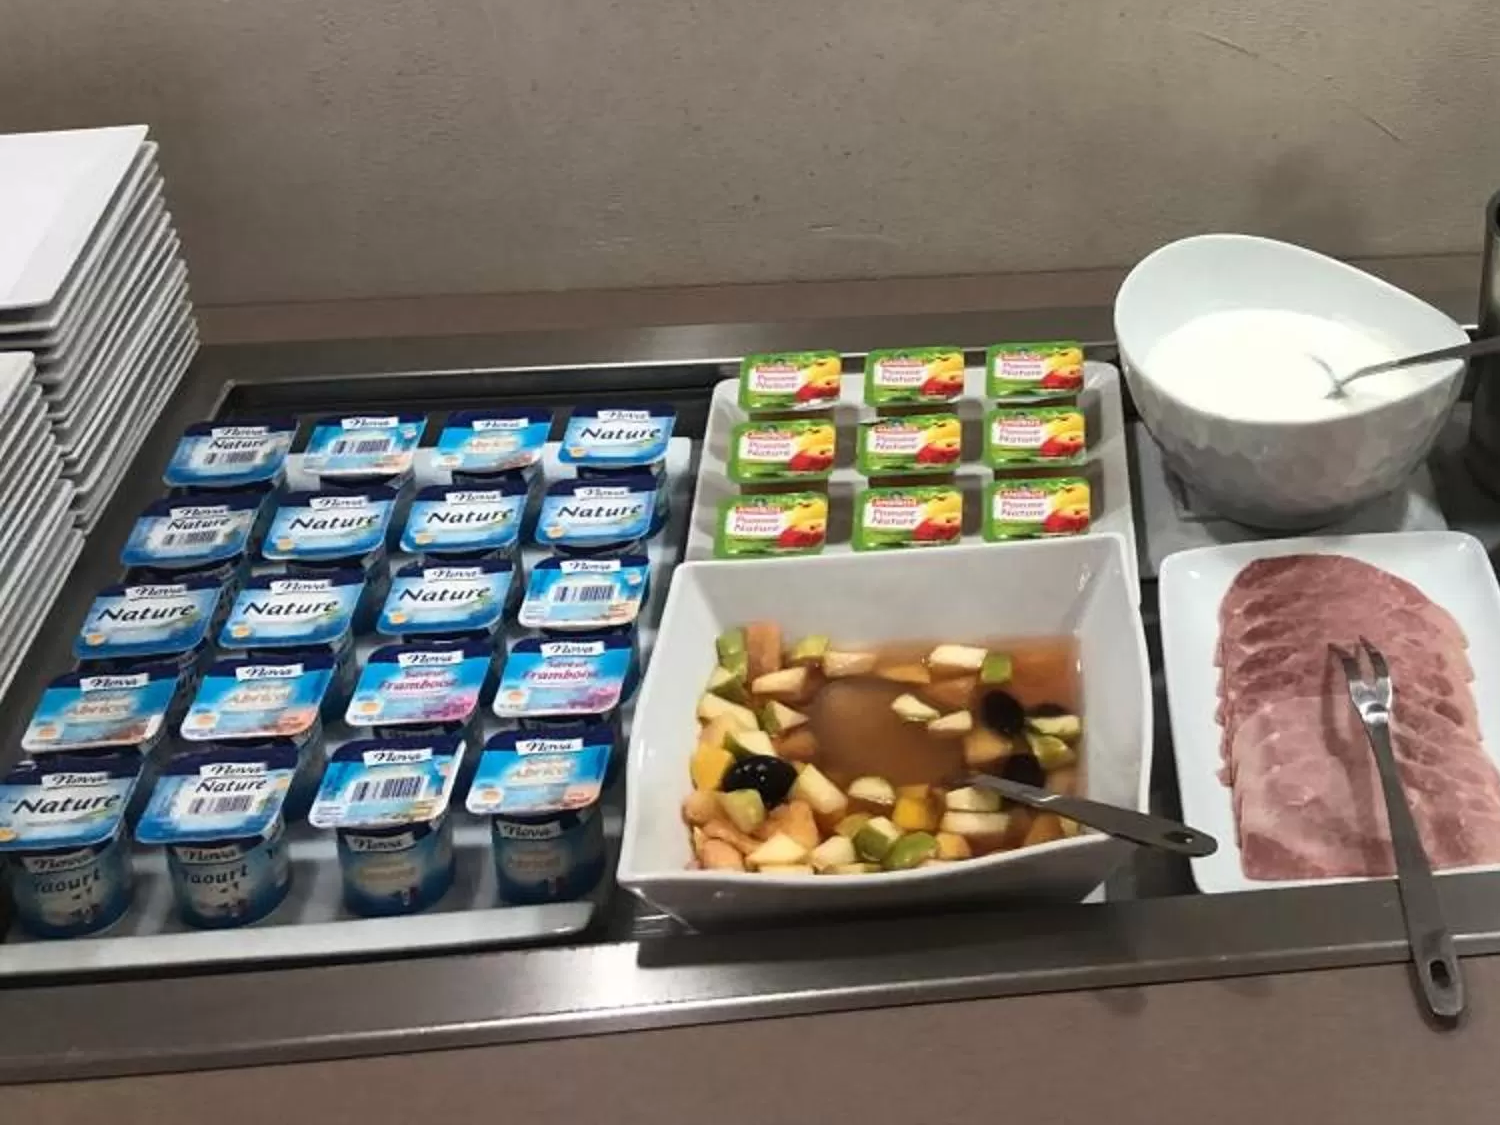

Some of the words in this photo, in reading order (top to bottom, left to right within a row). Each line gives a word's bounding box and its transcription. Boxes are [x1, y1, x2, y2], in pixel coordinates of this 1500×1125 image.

[580, 426, 662, 441] Nature
[208, 437, 269, 450] Nature
[426, 507, 515, 525] Nature
[557, 503, 644, 519] Nature
[167, 517, 232, 531] Nature
[289, 513, 380, 531] Nature
[399, 585, 492, 603] Nature
[97, 602, 197, 622] Nature
[242, 599, 340, 617] Nature
[196, 778, 268, 794] Nature
[12, 794, 122, 816] Nature
